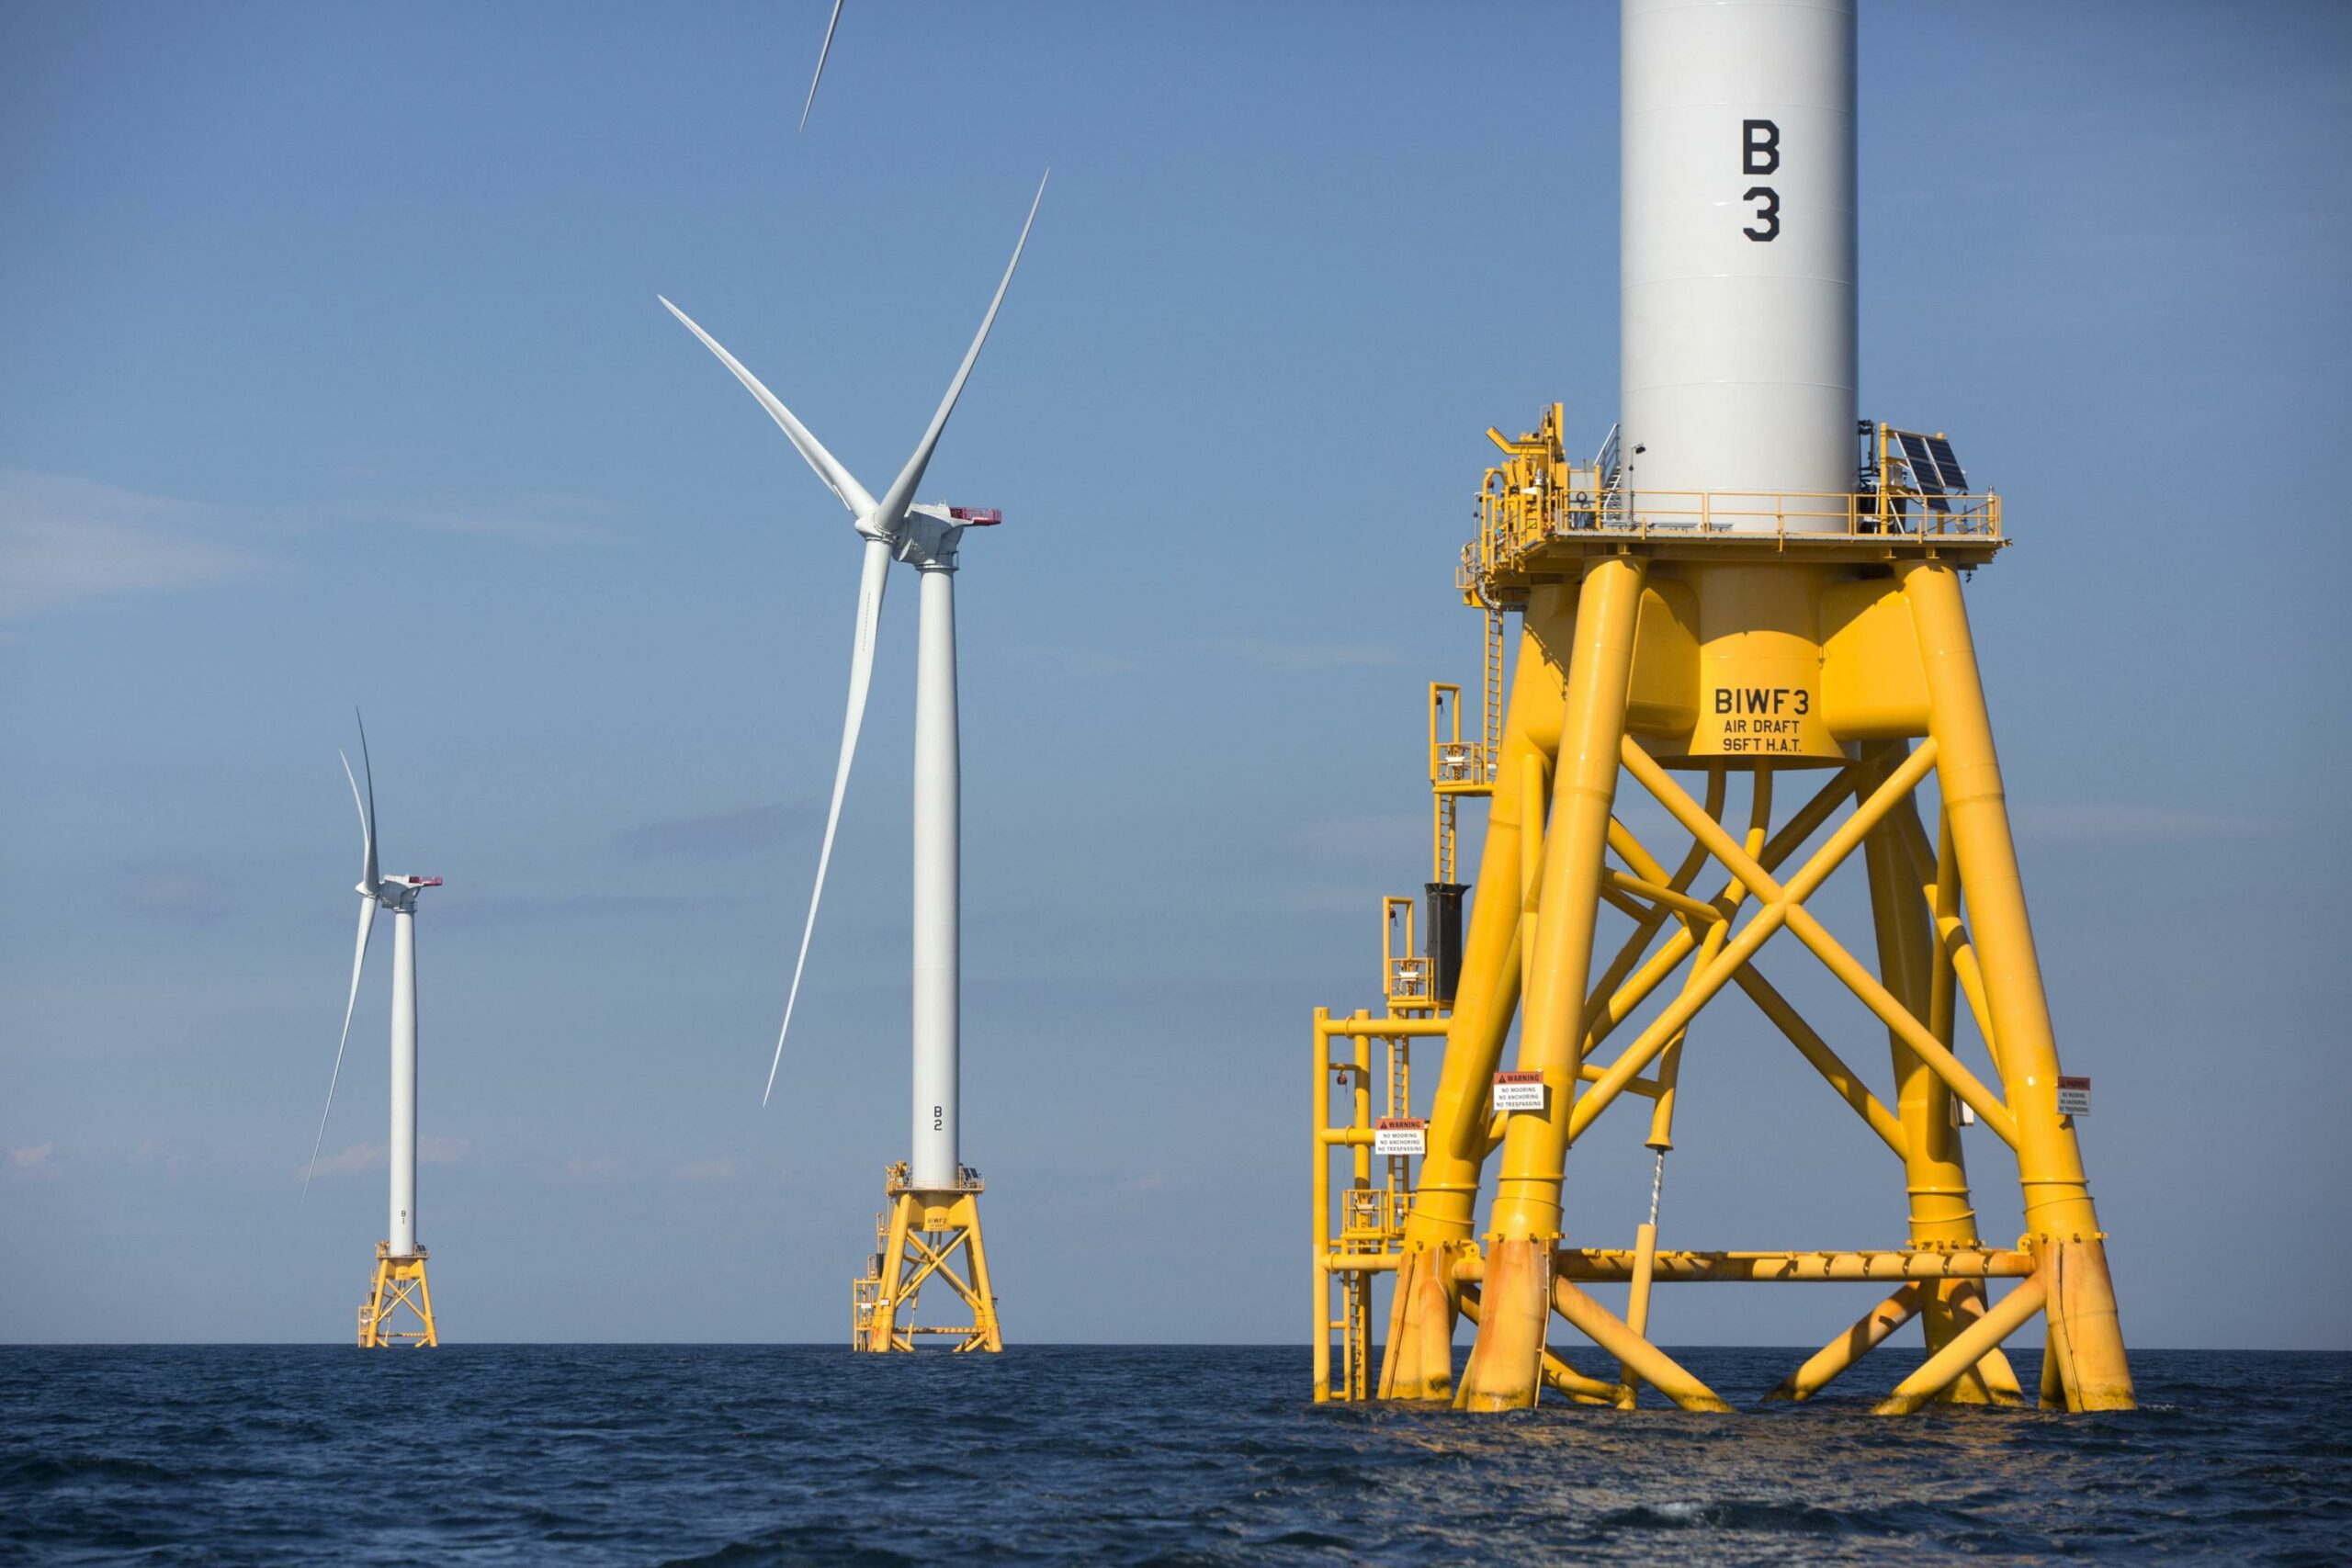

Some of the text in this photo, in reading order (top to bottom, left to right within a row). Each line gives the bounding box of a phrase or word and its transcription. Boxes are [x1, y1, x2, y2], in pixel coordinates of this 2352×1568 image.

[1743, 119, 1780, 175] B
[1743, 186, 1780, 242] 3
[1715, 688, 1809, 715] BIWF3
[1724, 719, 1800, 734] AIR DRAFT
[1723, 738, 1803, 752] 96FT H.A.T.
[1508, 1074, 1540, 1082] WARNING
[934, 1106, 942, 1118] B
[934, 1119, 942, 1131] 2
